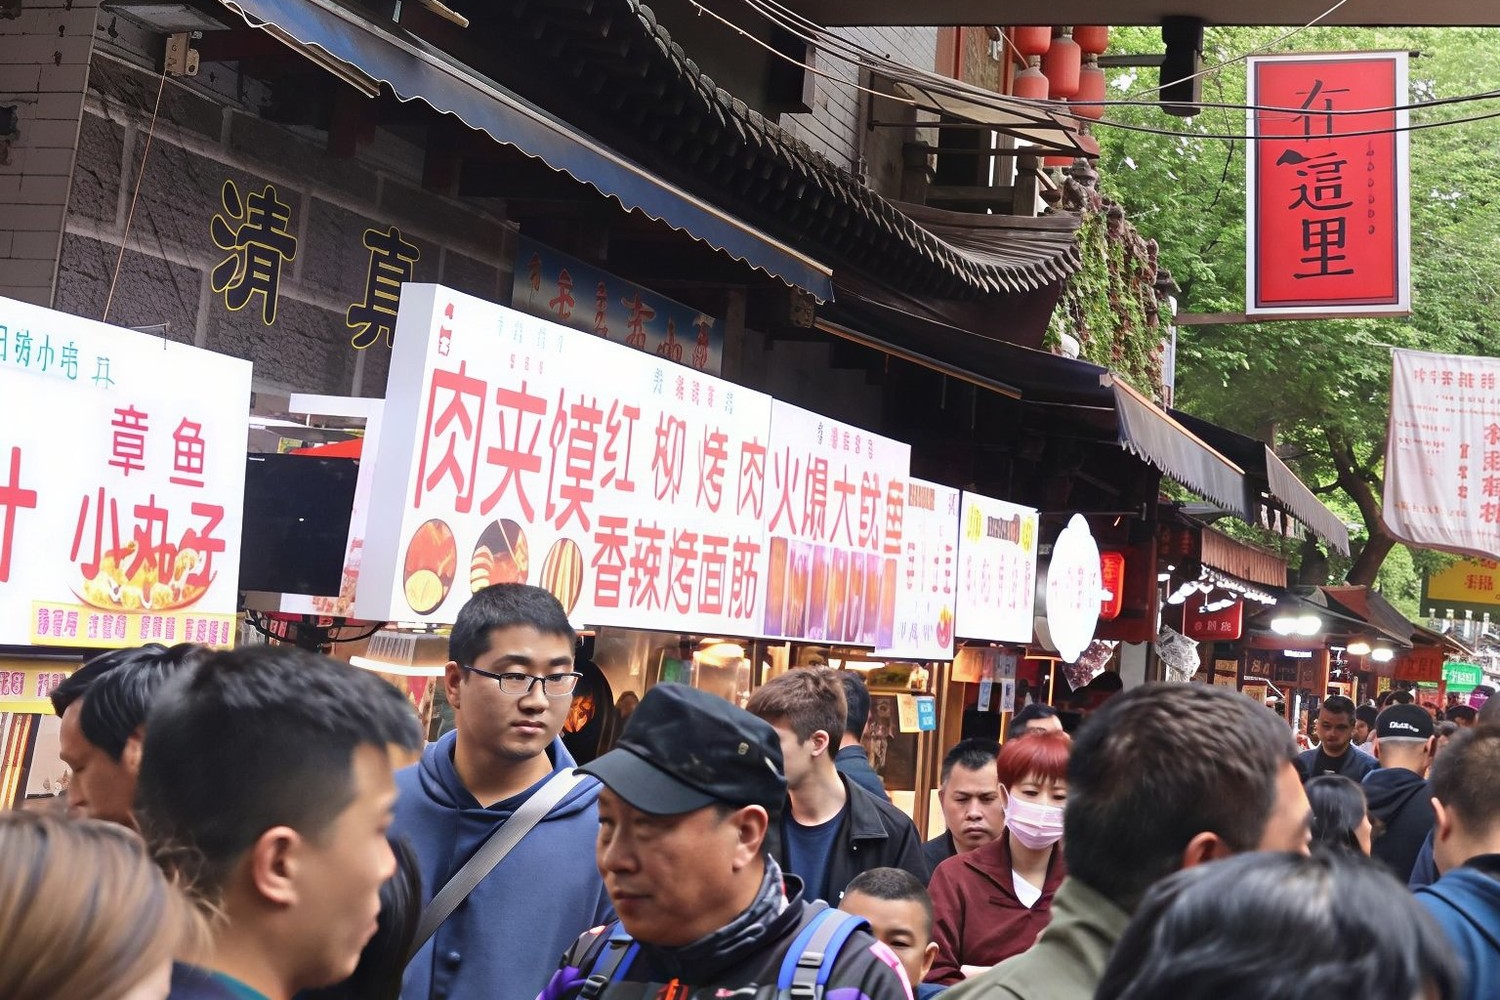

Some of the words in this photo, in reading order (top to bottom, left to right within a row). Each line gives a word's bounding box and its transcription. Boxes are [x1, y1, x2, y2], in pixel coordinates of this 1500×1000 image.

[210, 179, 420, 350] 清真
[107, 404, 207, 489] 章鱼
[413, 359, 604, 533] 肉夹馍
[69, 486, 226, 584] 小丸子
